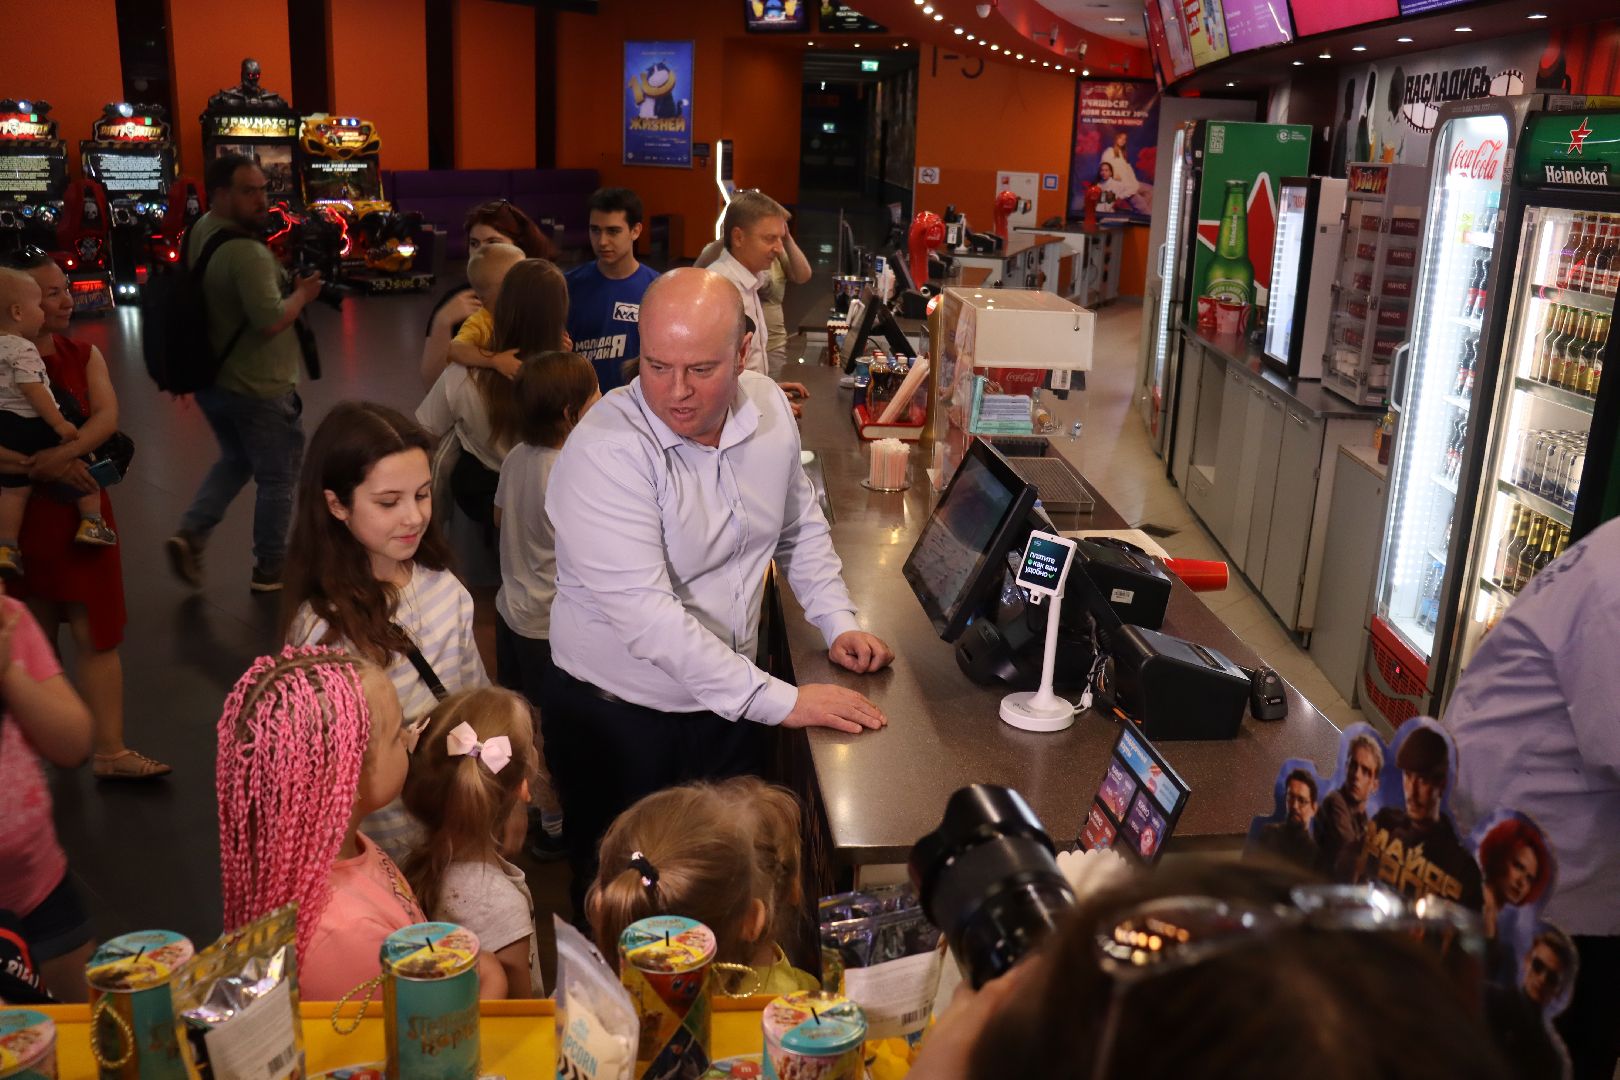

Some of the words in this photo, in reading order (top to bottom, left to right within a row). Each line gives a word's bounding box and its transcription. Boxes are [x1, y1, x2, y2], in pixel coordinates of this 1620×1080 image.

[1404, 66, 1491, 104] НАСЛАДИСЬ
[214, 116, 295, 126] TERMINATOR
[630, 118, 686, 132] ЖИЗНЕЙ
[1449, 139, 1503, 181] Coca-Cola
[1545, 164, 1608, 186] Heineken
[1030, 552, 1055, 564] платите
[1025, 566, 1048, 578] удобно
[1045, 564, 1057, 572] вам
[1365, 820, 1463, 900] МАЙОР
